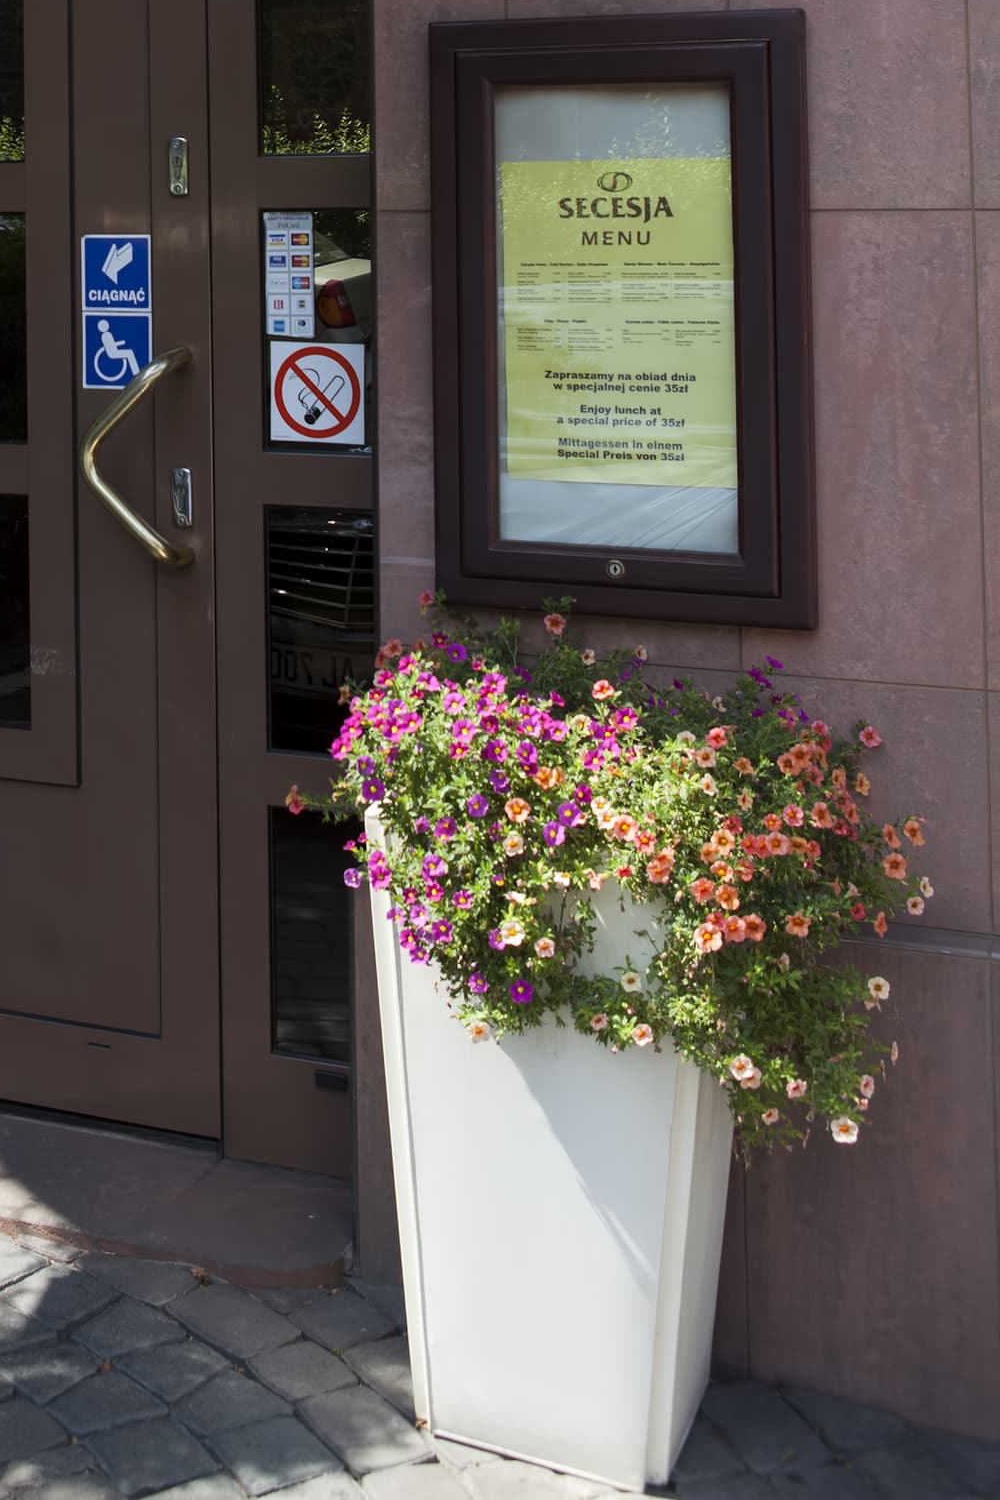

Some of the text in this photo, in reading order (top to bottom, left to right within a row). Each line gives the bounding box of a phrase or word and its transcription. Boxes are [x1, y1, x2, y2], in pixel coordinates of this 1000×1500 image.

[558, 196, 675, 224] SECESJA
[580, 230, 652, 246] MENU
[88, 286, 146, 305] CIĄGNĄĆ
[544, 370, 697, 382] Zapraszamy na obiad dnia
[566, 383, 626, 393] specjalnej
[629, 383, 662, 393] cenie
[664, 384, 689, 393] 35zł
[580, 404, 662, 415] Enjoy lunch at
[556, 416, 564, 424] a
[567, 416, 609, 426] special
[612, 417, 642, 427] price
[645, 418, 658, 426] of
[558, 437, 683, 450] Mittagessen in einem
[557, 449, 599, 459] Special
[603, 450, 633, 460] Preis
[636, 453, 657, 461] von
